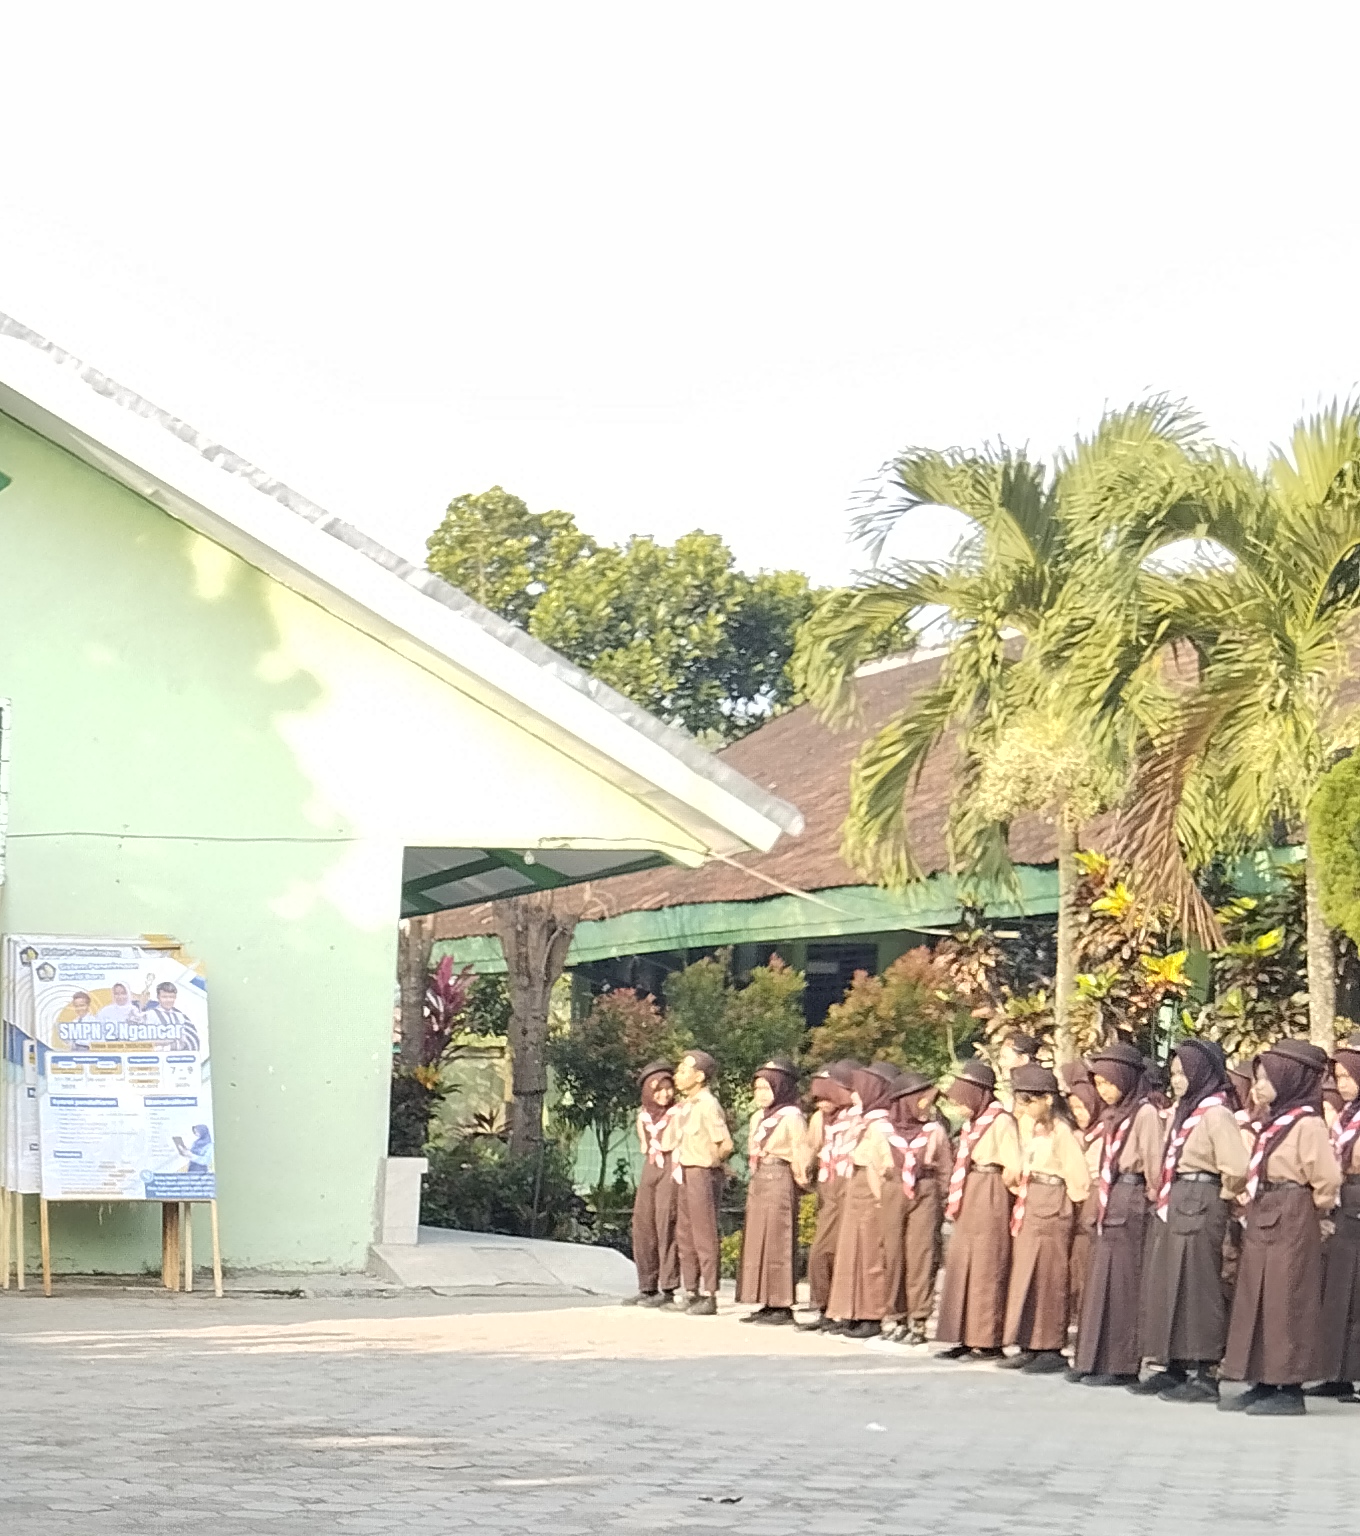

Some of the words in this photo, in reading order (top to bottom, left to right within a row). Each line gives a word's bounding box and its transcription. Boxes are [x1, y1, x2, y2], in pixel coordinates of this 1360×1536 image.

[59, 1022, 101, 1040] SMPN
[105, 1023, 117, 1040] 2
[119, 1023, 183, 1041] Ngancar
